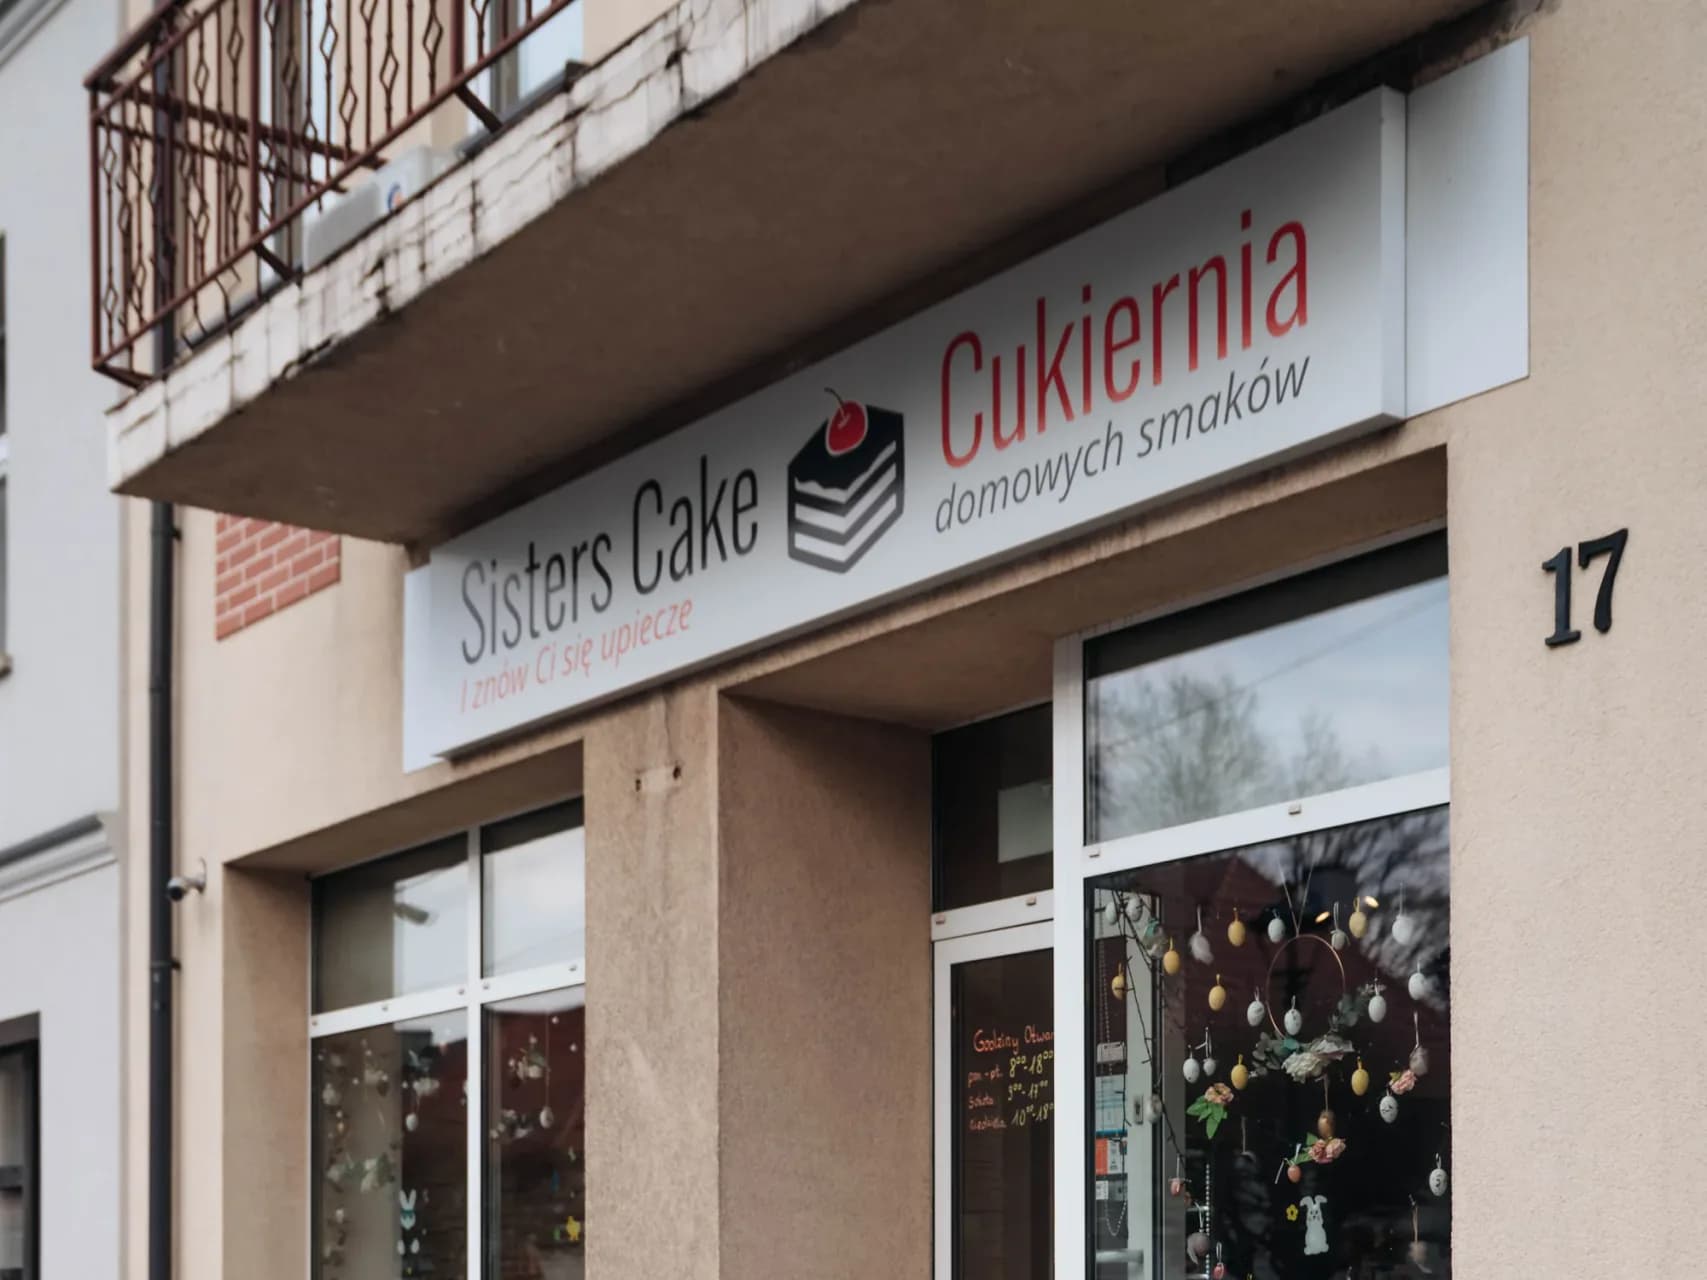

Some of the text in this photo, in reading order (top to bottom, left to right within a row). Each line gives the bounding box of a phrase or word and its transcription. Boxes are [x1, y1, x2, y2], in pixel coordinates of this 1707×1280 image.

[941, 210, 1309, 469] Cukiernia
[935, 356, 1312, 534] domowych smaków
[461, 453, 760, 665] Sisters Cake
[1541, 527, 1629, 649] 17
[471, 656, 529, 709] znów
[535, 641, 557, 685] Ci
[561, 632, 594, 678] się
[600, 598, 694, 669] upiecze
